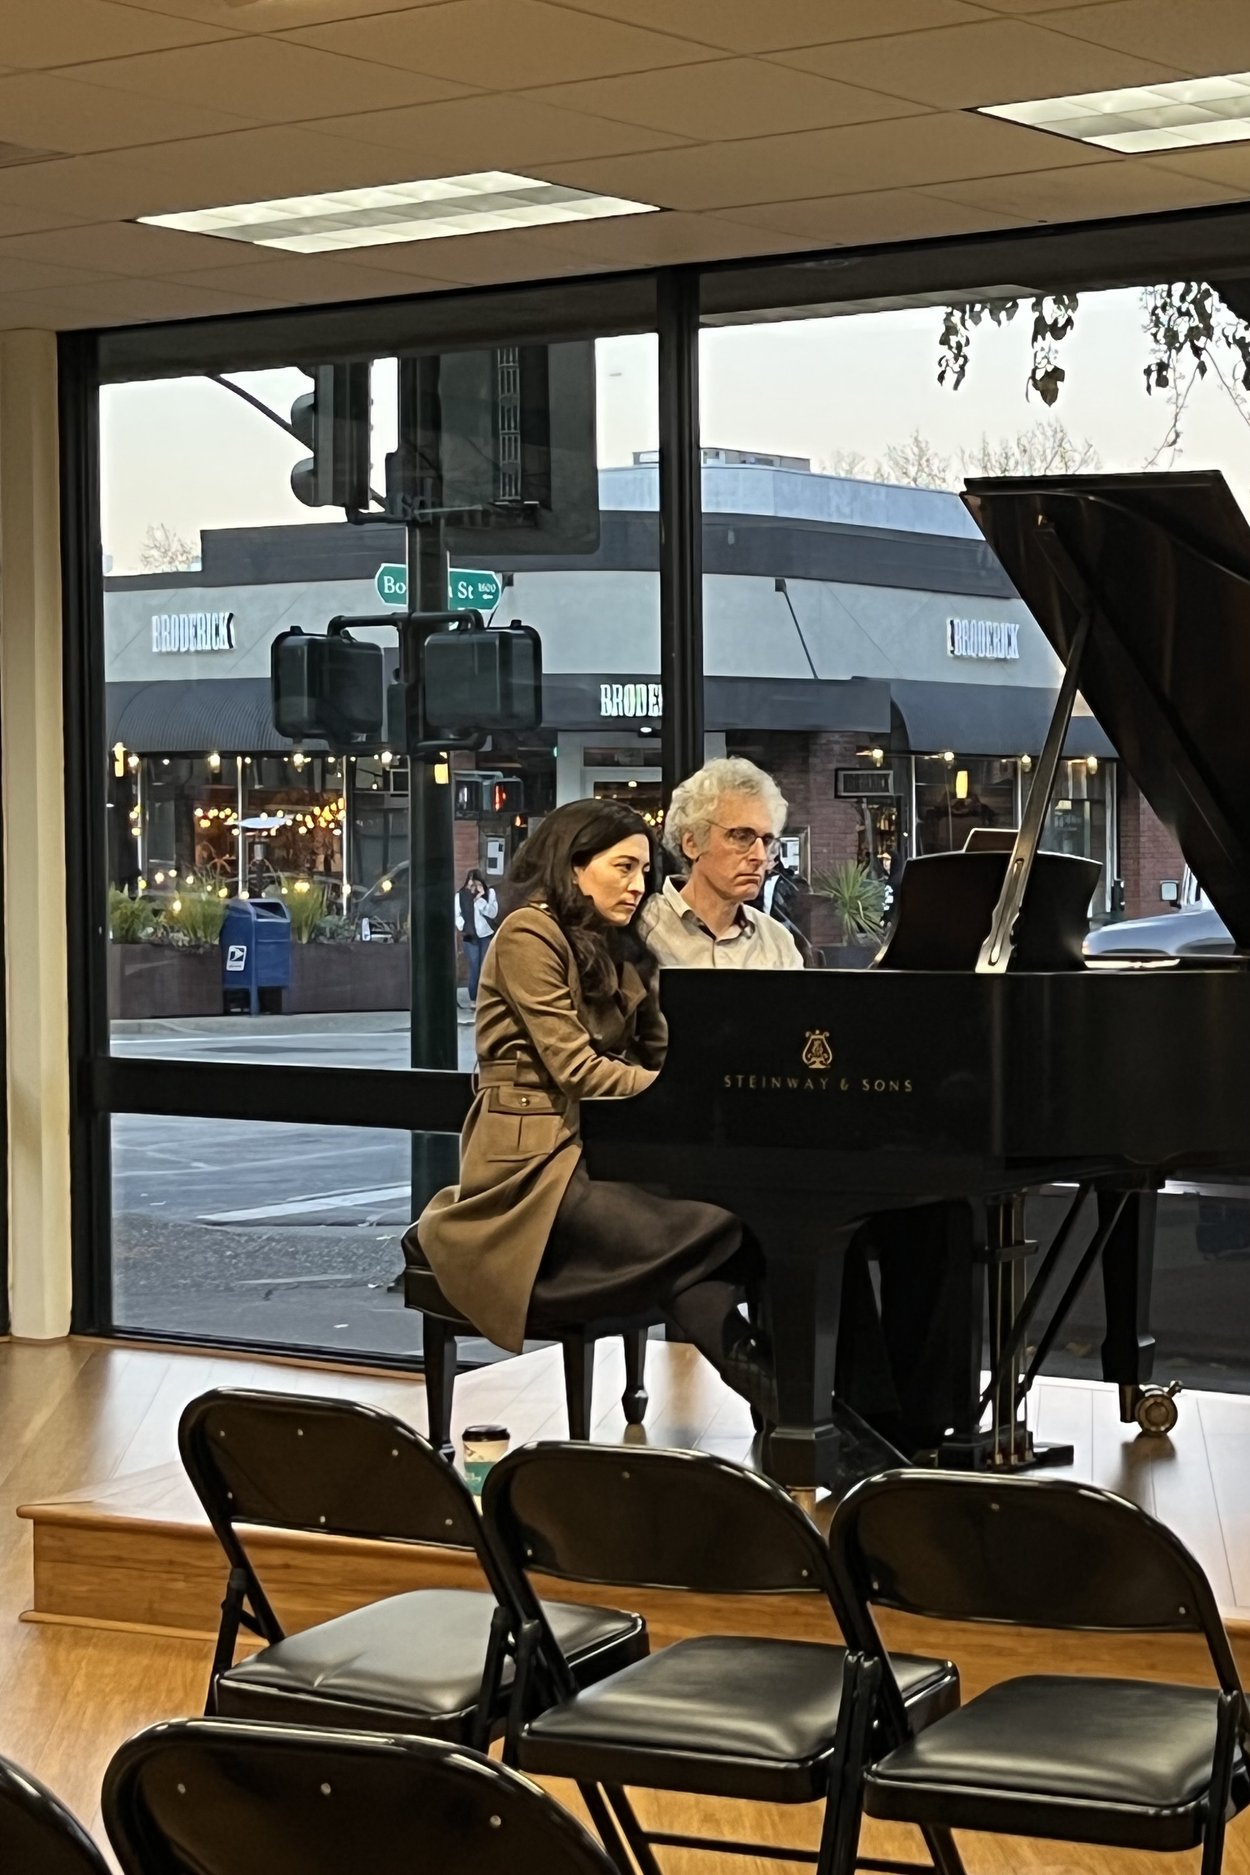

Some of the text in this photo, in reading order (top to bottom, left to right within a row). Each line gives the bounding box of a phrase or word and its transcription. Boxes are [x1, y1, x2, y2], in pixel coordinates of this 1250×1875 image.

[457, 580, 474, 599] St
[152, 611, 234, 653] BRODERICK
[949, 619, 1020, 659] BRODERICK
[600, 683, 663, 717] BRODE
[724, 1074, 913, 1092] STEINWAY & SONS
